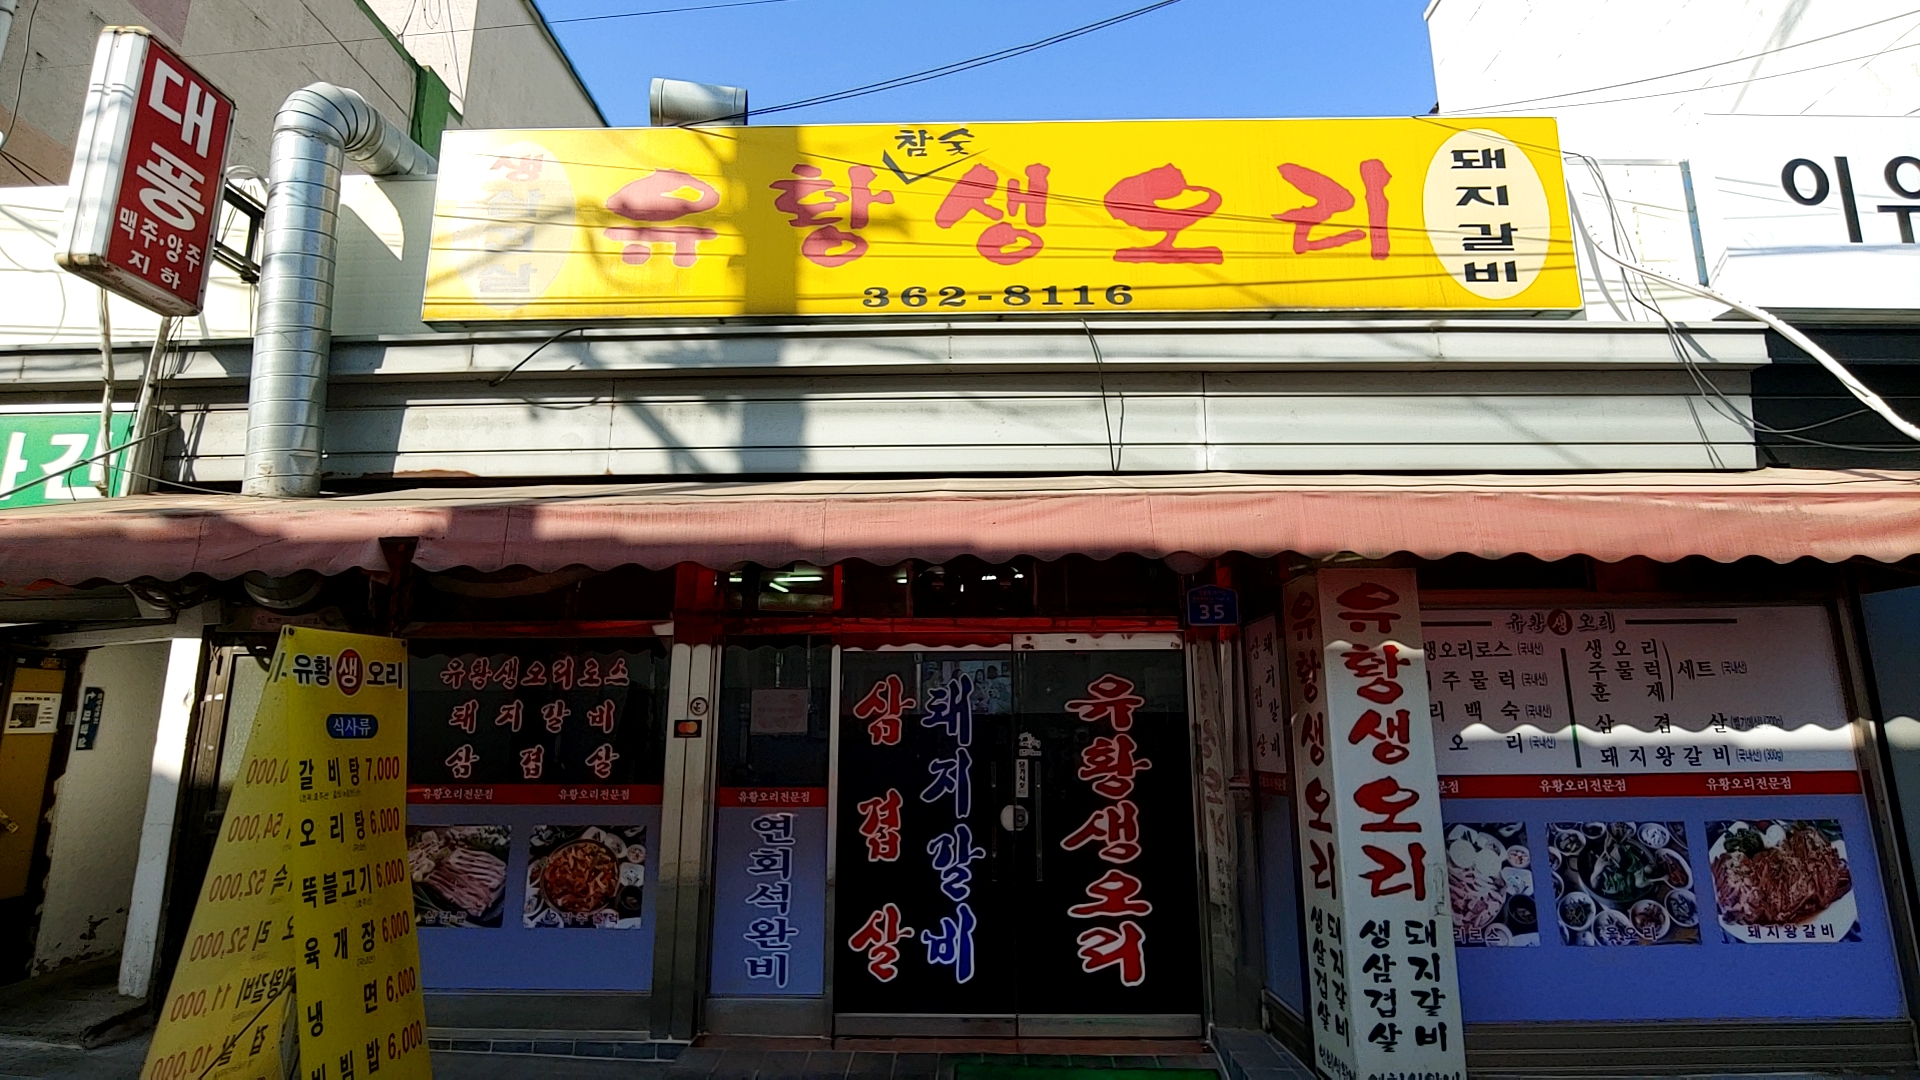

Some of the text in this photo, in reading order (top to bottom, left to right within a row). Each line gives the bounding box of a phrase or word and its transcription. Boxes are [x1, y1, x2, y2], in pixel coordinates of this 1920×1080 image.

[138, 58, 217, 231] 대풍
[894, 129, 975, 157] 참숯
[1451, 147, 1519, 284] 돼지갈비
[128, 250, 180, 290] 지하
[862, 284, 1134, 307] 362-8116
[1199, 603, 1225, 620] 35
[1585, 638, 1659, 660] 생오리
[293, 653, 403, 690] 유황생오리
[440, 655, 630, 691] 유황생오리로스
[1588, 659, 1661, 681] 주물럭
[1677, 658, 1716, 680] 세트
[1590, 681, 1665, 702] 훈제
[332, 716, 372, 737] 식사류
[449, 698, 616, 735] 돼지갈비
[1595, 712, 1727, 734] 삼겹살
[1290, 591, 1337, 900] 유황생오리
[1336, 582, 1427, 901] 유황생오리
[1600, 744, 1731, 768] 돼지왕갈비
[299, 756, 400, 791] 갈비탕 7,000
[445, 742, 620, 779] 삼겹살
[422, 788, 494, 801] 유황오리전문점
[557, 788, 630, 802] 유황오리전문점
[738, 790, 811, 803] 유황오리전문점
[1539, 778, 1627, 793] 유황오리전문점
[1706, 777, 1792, 791] 유황오리전문점
[300, 807, 400, 847] 오리탕 6,000
[848, 672, 918, 983] 삼겹살
[919, 672, 987, 985] 돼지갈비
[1060, 672, 1153, 987] 유황생오리
[302, 858, 405, 909] 뚝불고기 6,000
[744, 812, 799, 989] 연회석완비
[304, 911, 410, 970] 육개장 6,000
[1747, 925, 1835, 940] 돼지왕갈비
[1327, 912, 1350, 1047] 돼지갈비
[1360, 920, 1403, 1053] 생삼겹살
[1405, 919, 1447, 1052] 돼지갈비
[307, 966, 416, 1038] 냉면 6,000
[388, 1020, 423, 1060] 6,000
